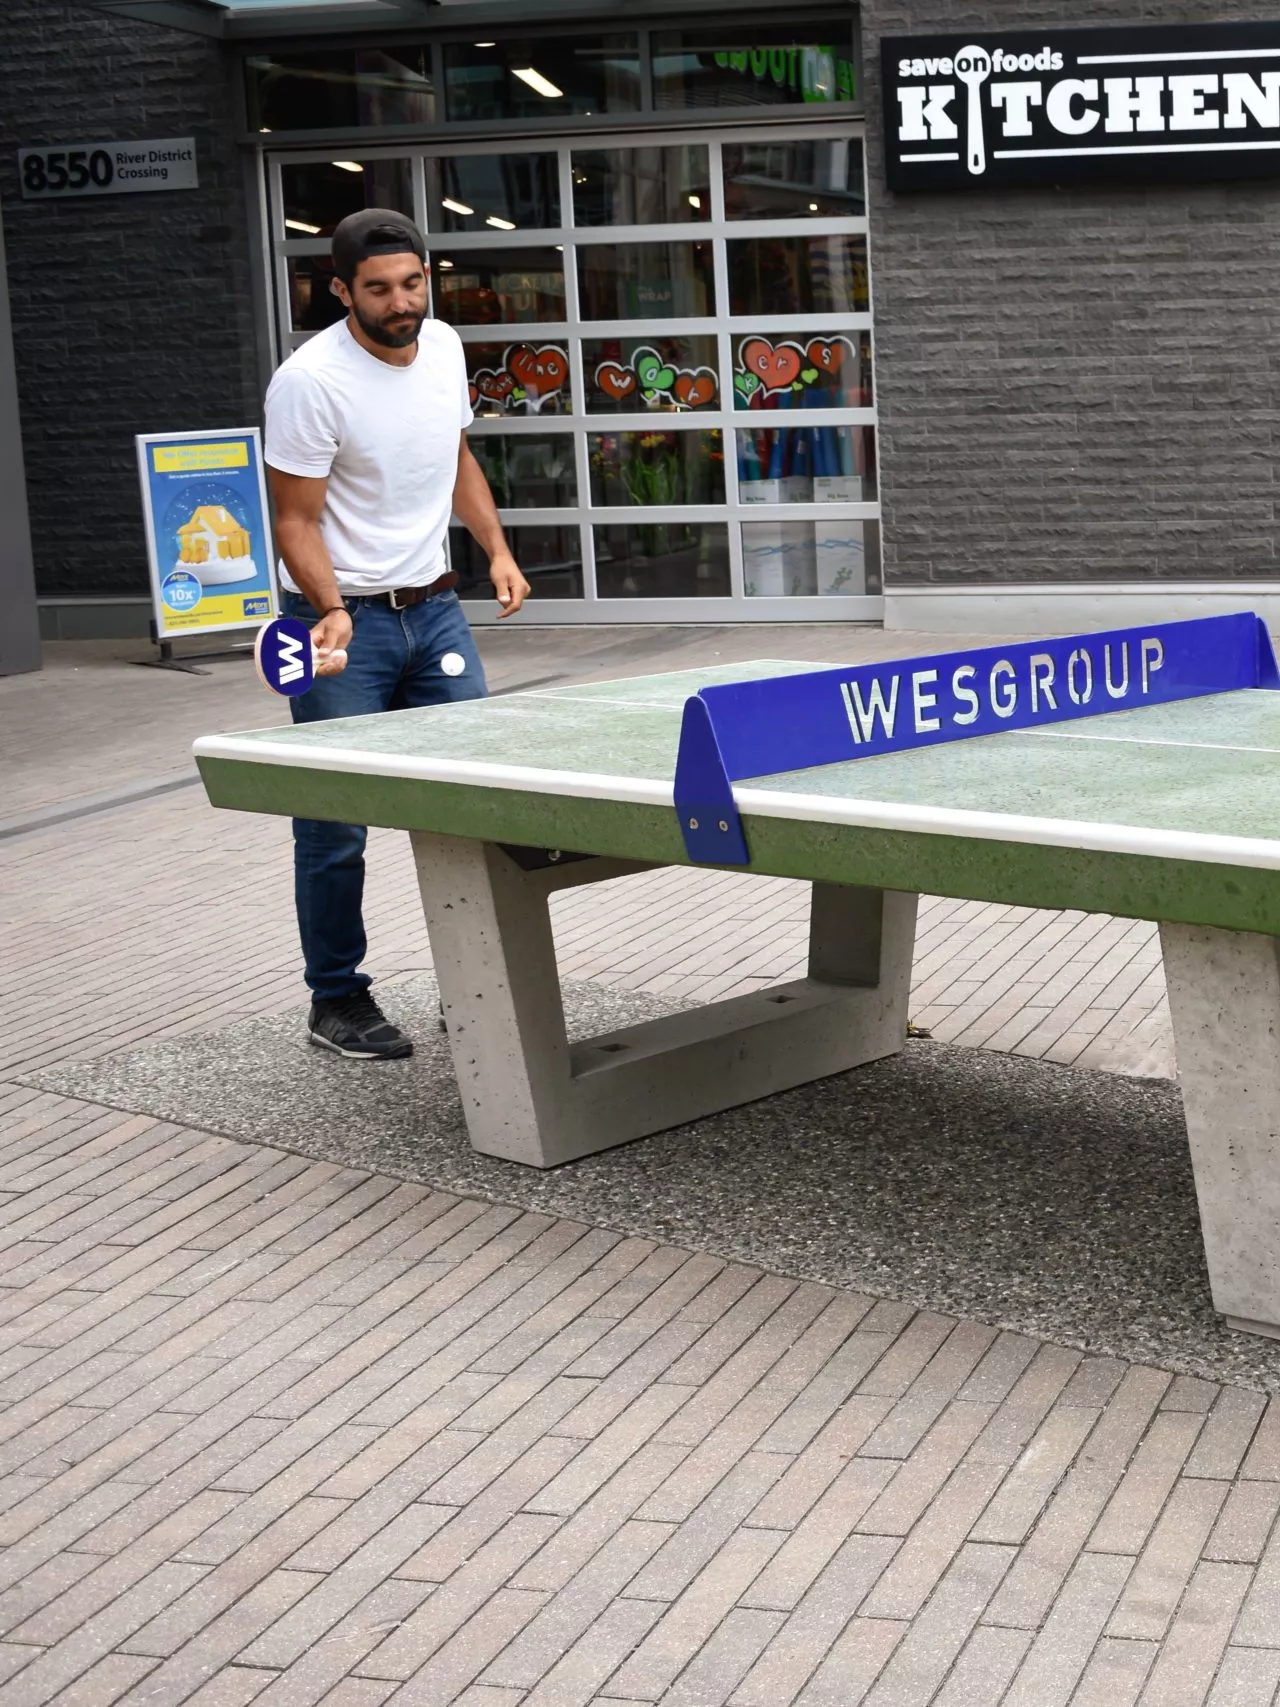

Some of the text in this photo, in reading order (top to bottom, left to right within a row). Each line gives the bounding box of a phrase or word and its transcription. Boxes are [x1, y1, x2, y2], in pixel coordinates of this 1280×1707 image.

[898, 46, 1064, 77] save on foods
[23, 149, 192, 191] 8550 River District
[117, 166, 168, 180] Crossing
[277, 631, 304, 685] W
[838, 636, 1166, 745] WESGROUP
